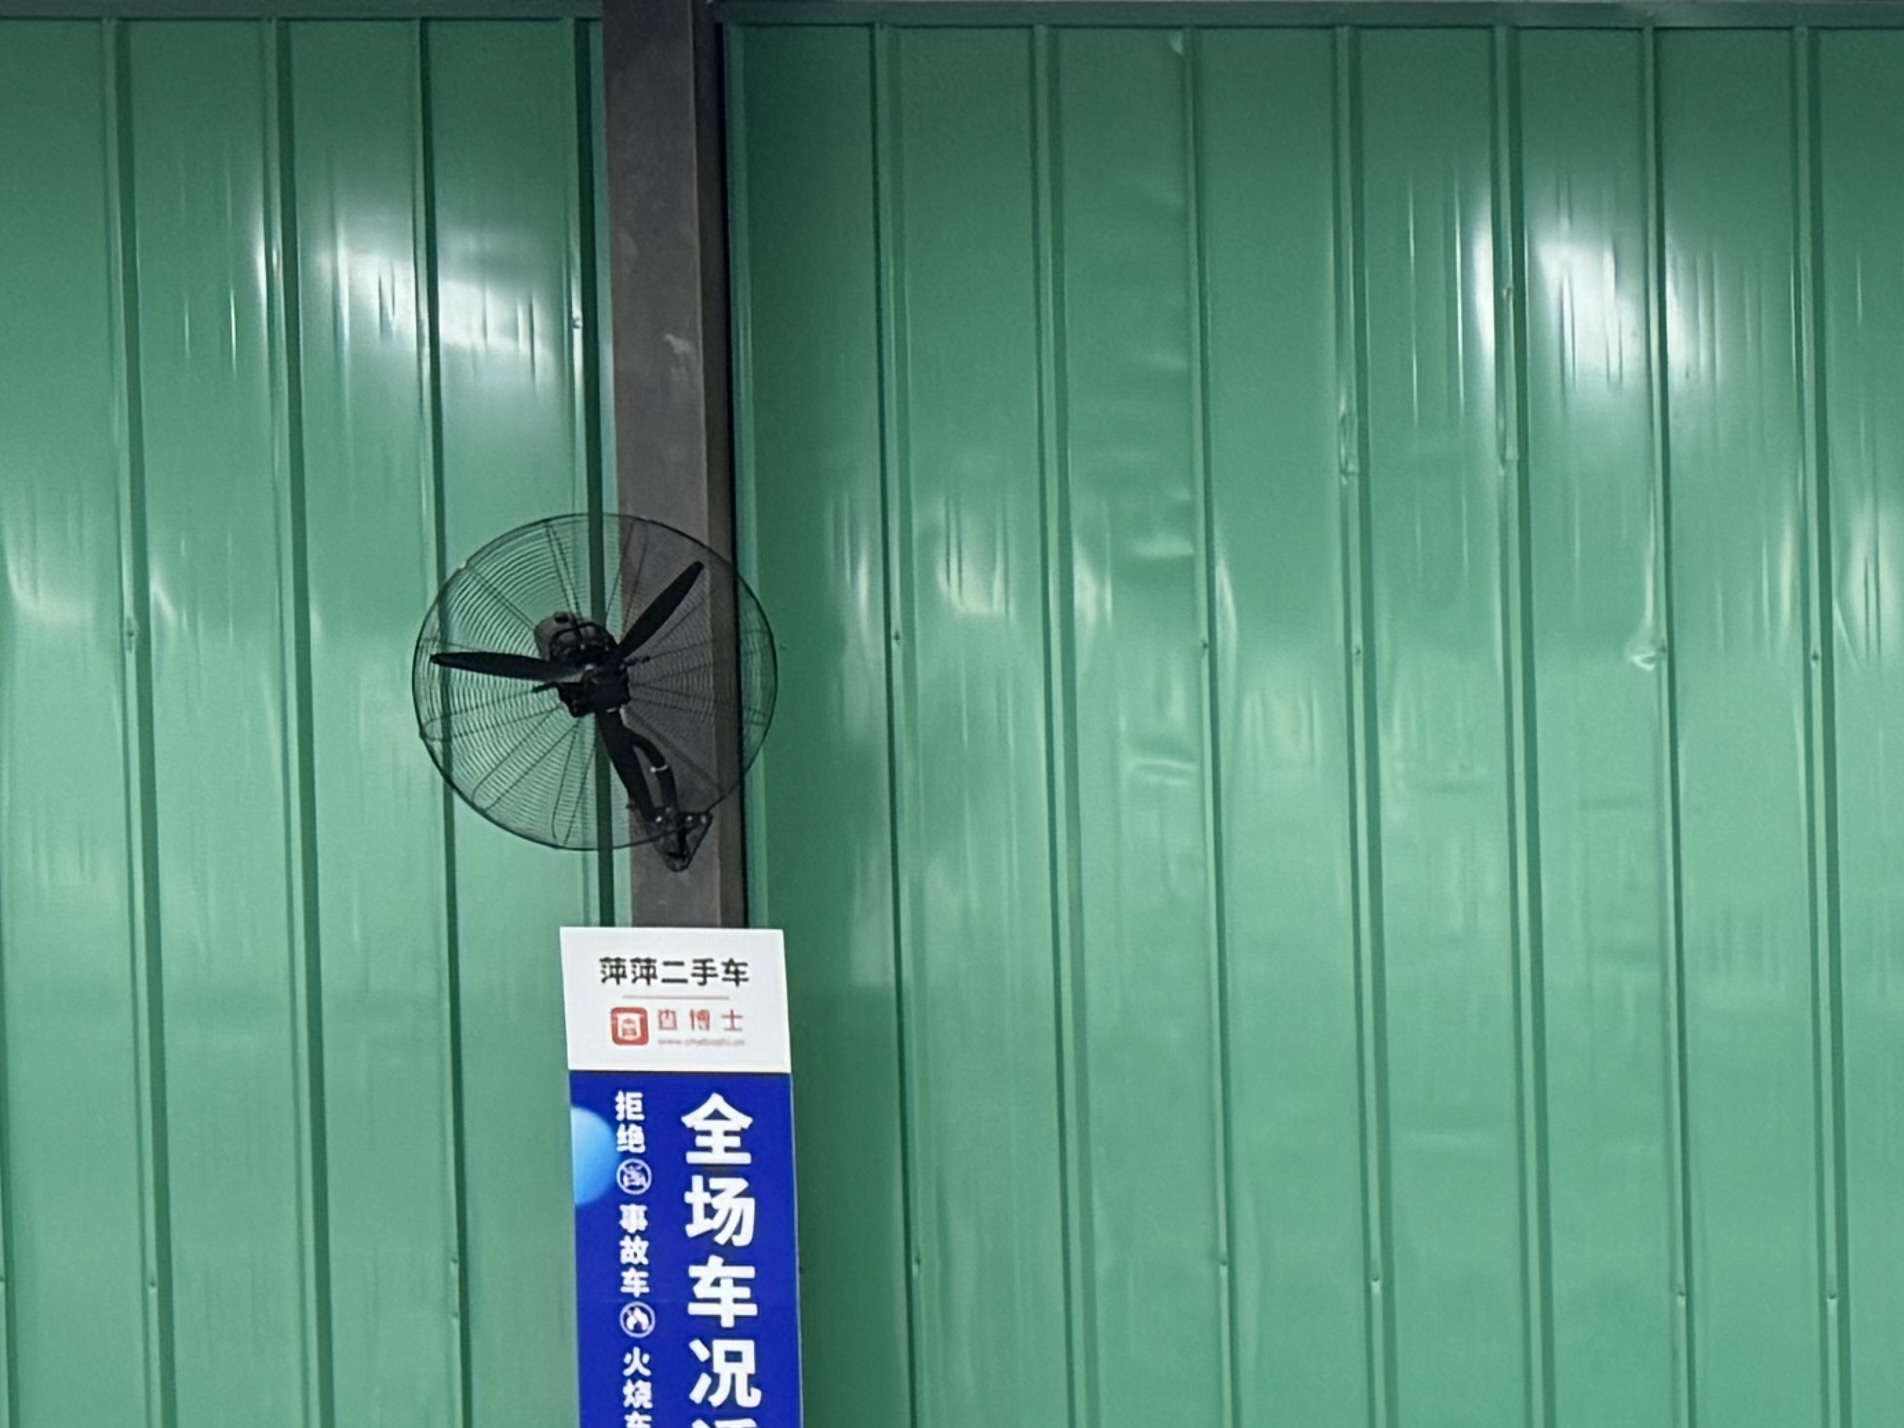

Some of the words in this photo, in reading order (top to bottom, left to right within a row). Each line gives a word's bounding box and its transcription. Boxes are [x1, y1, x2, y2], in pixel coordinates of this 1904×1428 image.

[599, 957, 749, 987] 萍萍二手车
[615, 1090, 645, 1153] 拒绝
[619, 1203, 650, 1298] 事故车
